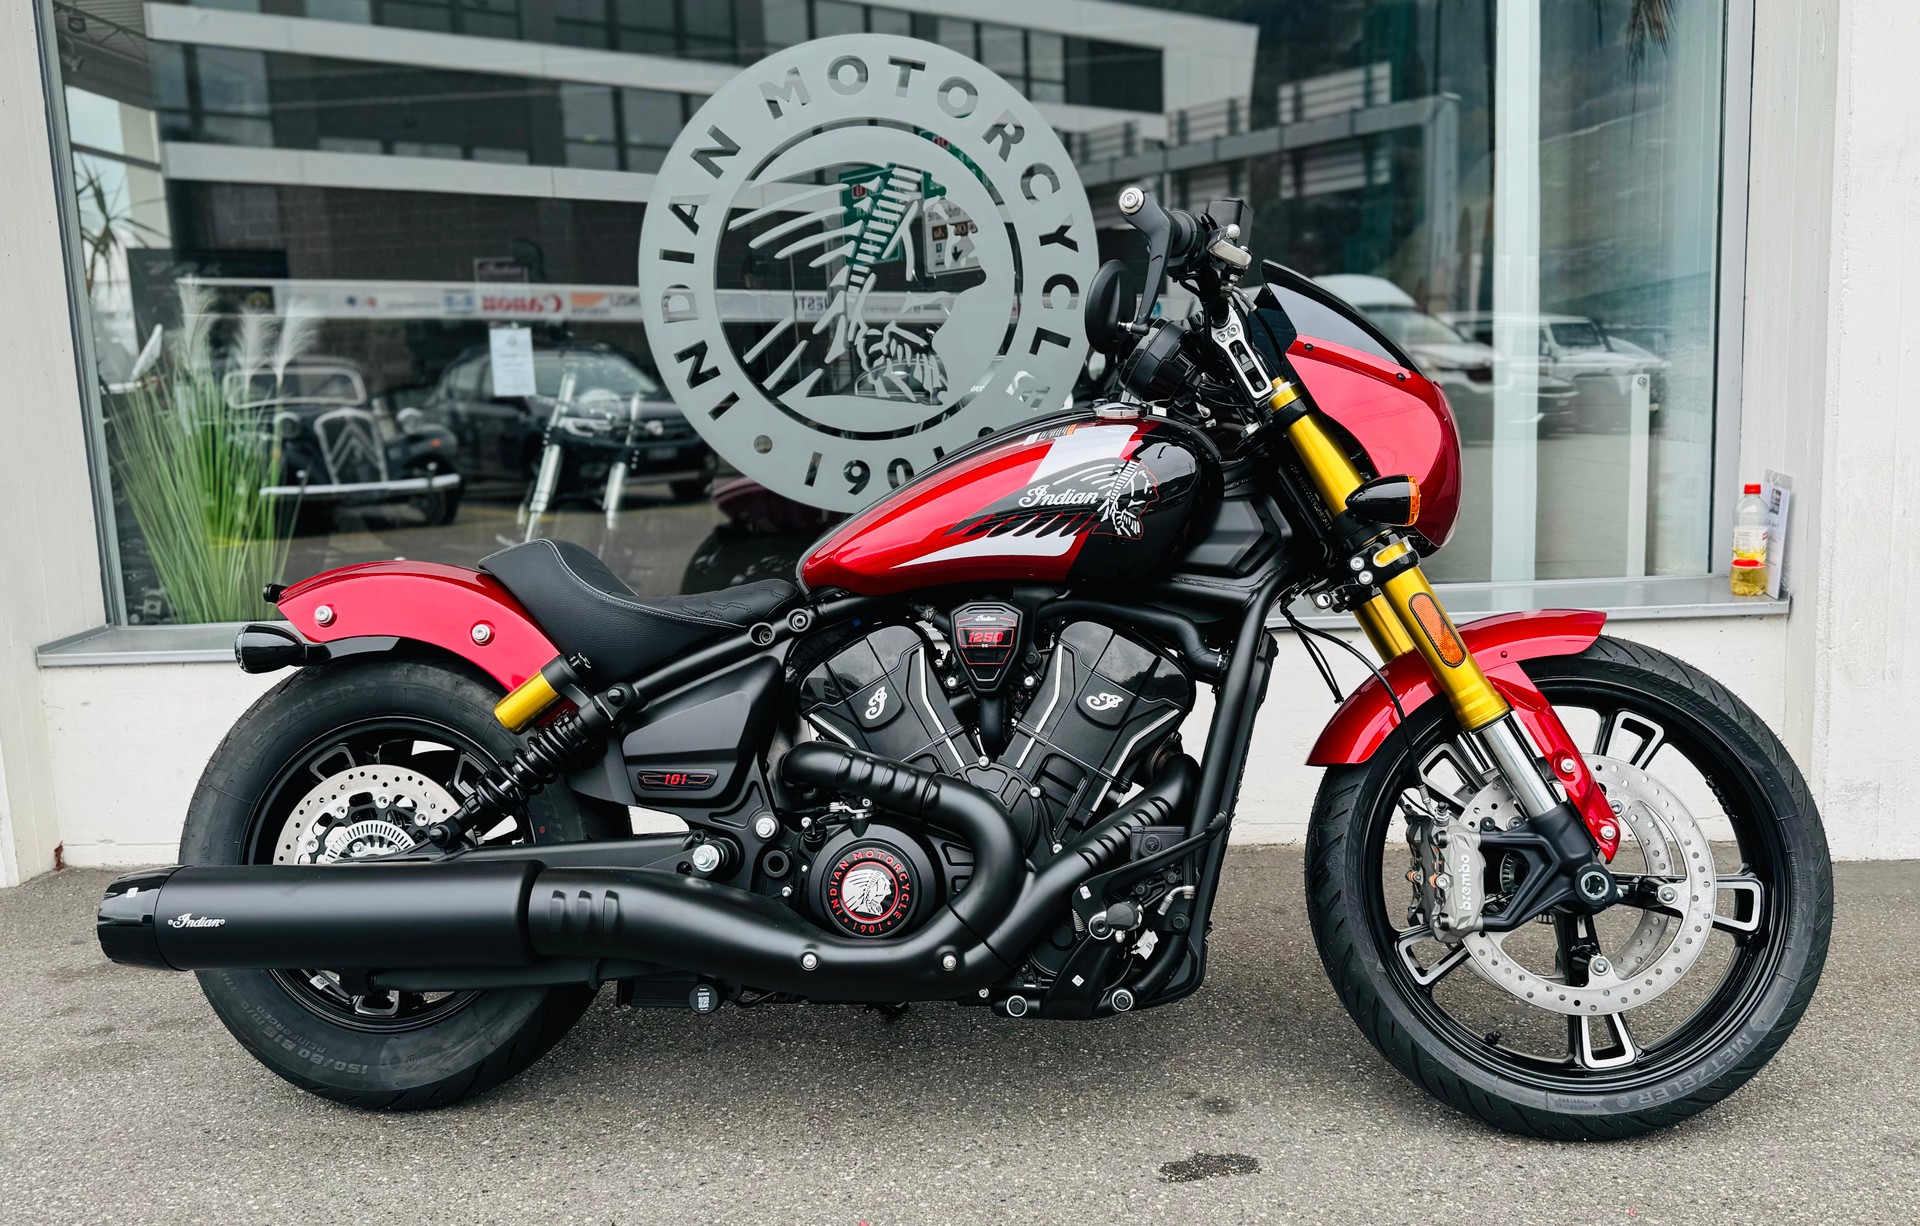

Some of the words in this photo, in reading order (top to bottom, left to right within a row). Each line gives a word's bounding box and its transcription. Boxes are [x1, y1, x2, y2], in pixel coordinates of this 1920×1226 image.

[659, 124, 741, 422] INDIAN
[759, 55, 1080, 411] MOTORCYCLE
[1018, 484, 1099, 508] Indian
[968, 631, 1004, 643] 1250
[664, 773, 688, 785] 101
[829, 860, 850, 916] INDIAN
[853, 849, 910, 920] MOTORCYCLE
[1458, 853, 1473, 911] brembo
[171, 912, 222, 929] Indian
[852, 922, 883, 933] 1901
[1637, 1031, 1755, 1105] METZELER
